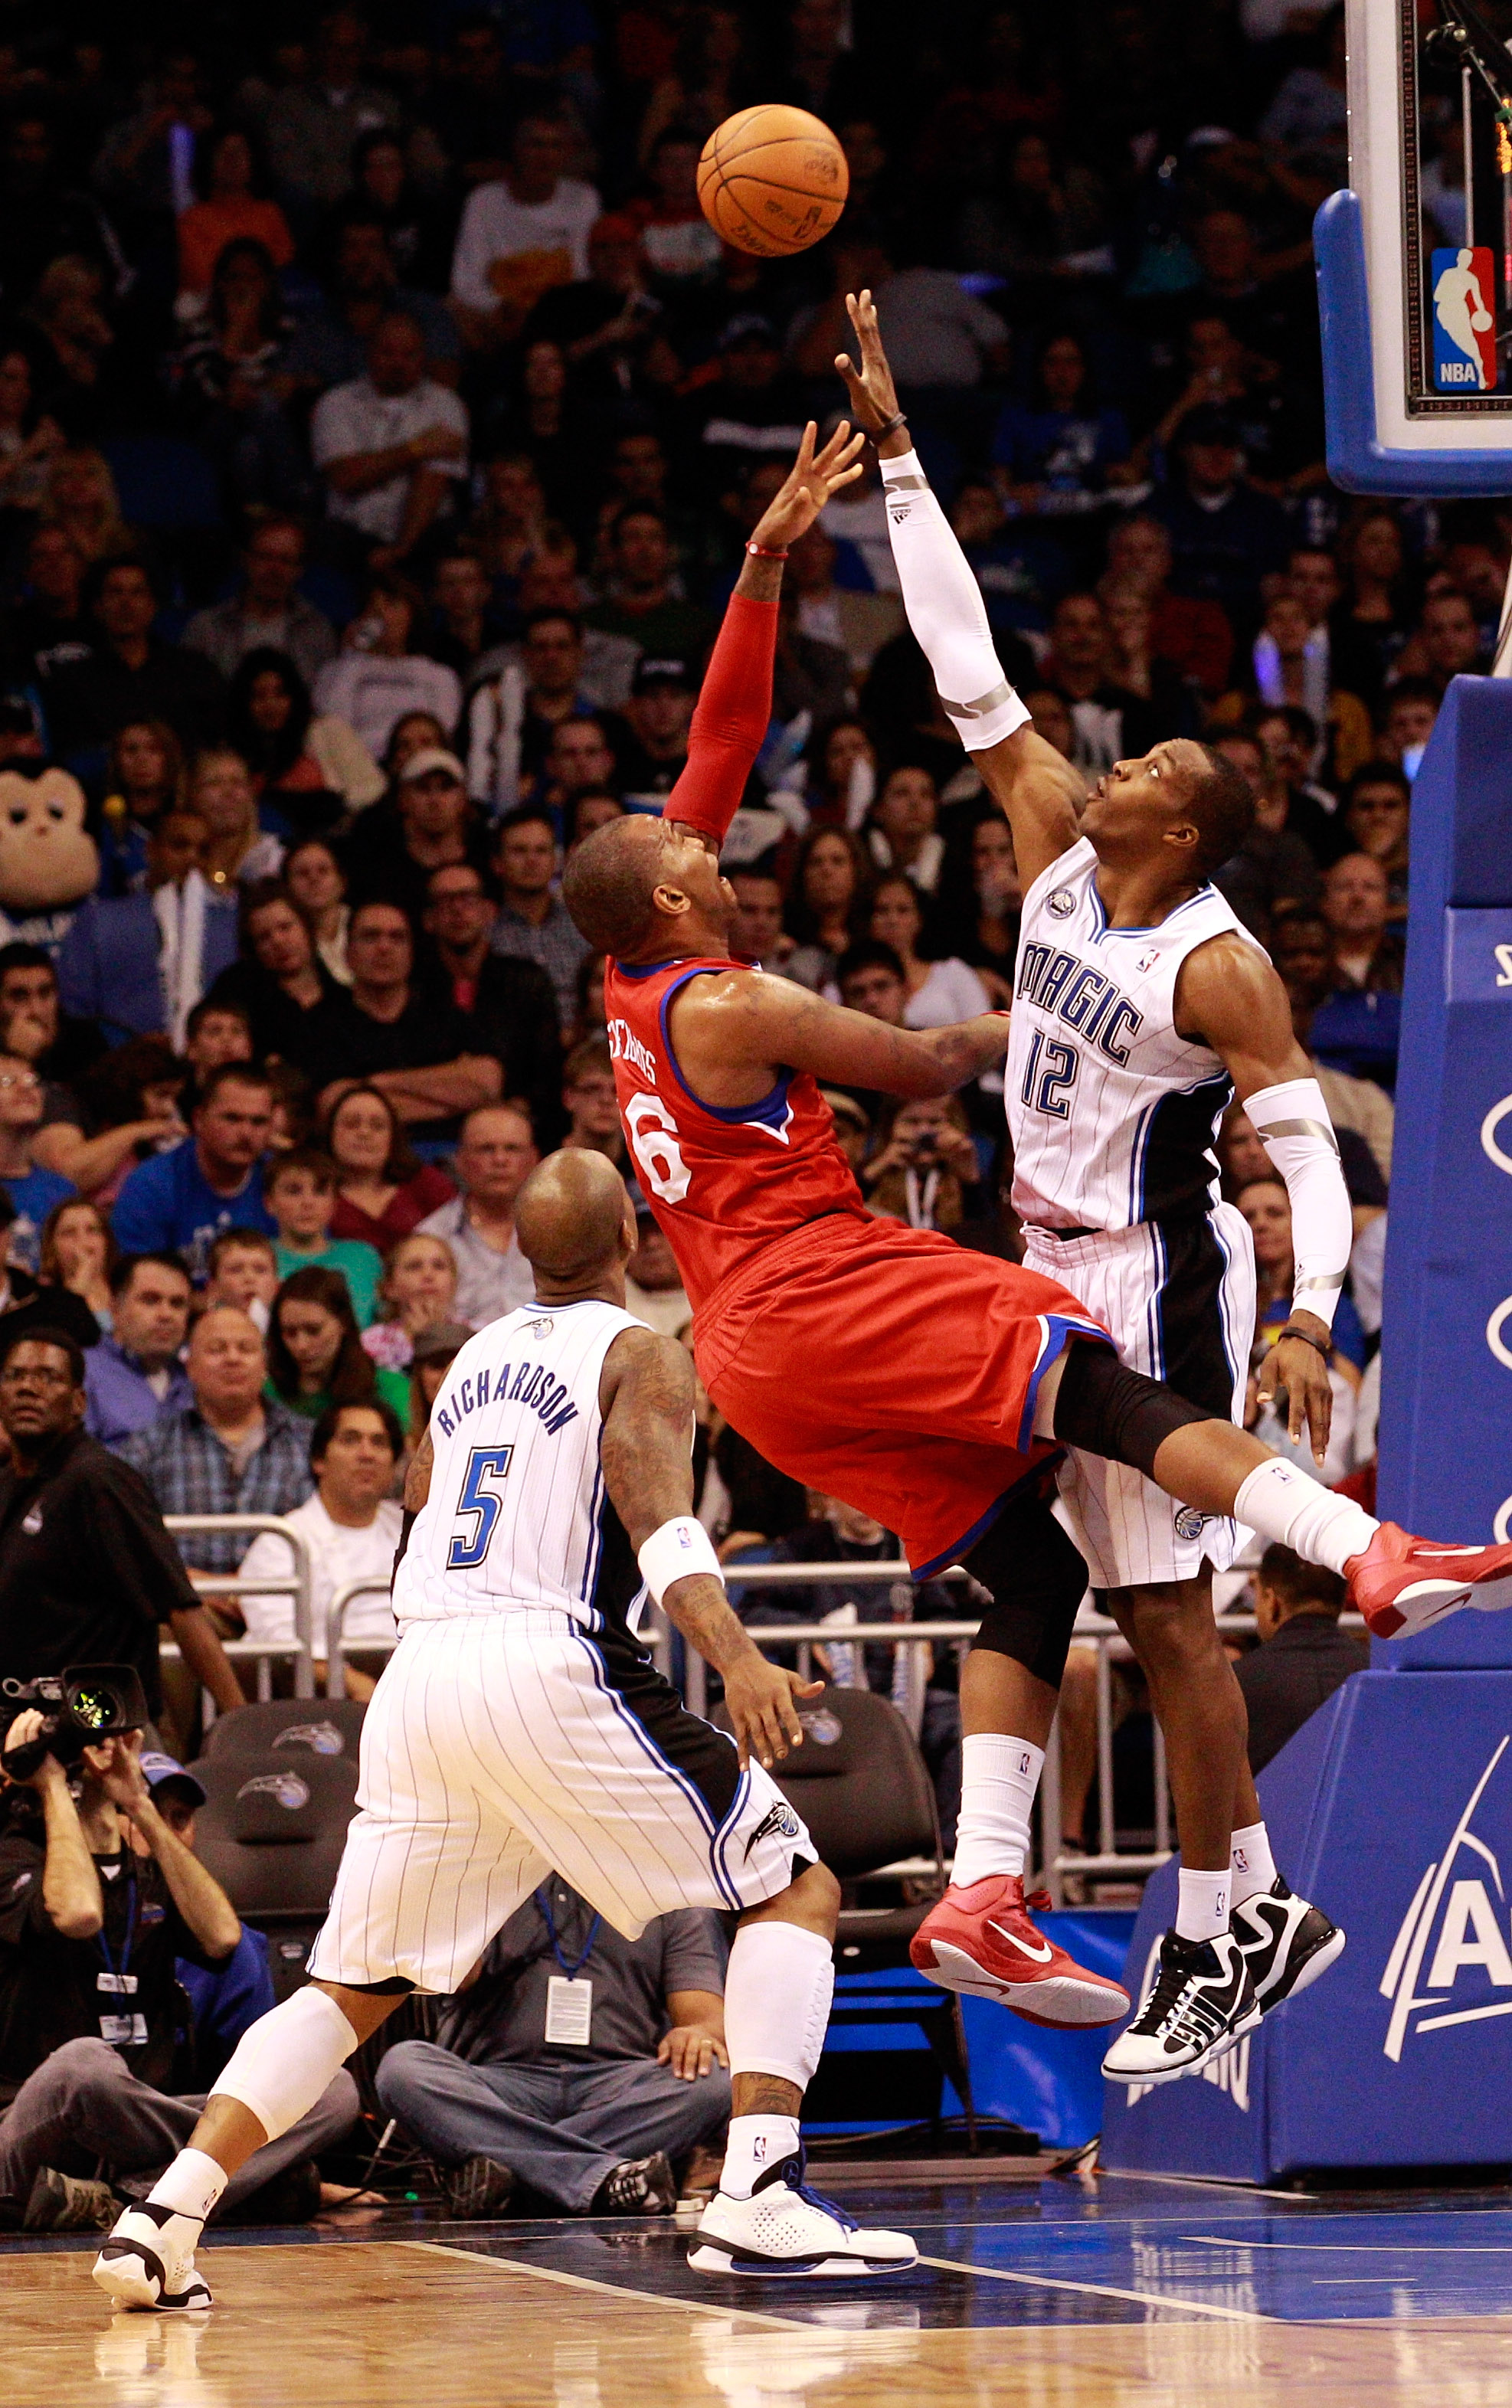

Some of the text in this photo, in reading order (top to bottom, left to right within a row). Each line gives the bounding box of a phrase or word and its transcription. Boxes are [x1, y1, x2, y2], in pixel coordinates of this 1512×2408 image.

[1440, 362, 1477, 383] NBA
[1016, 940, 1144, 1068] MAGIC
[1021, 1026, 1079, 1121] 12
[437, 1362, 580, 1437] RICHARDSON
[446, 1444, 515, 1570] 5
